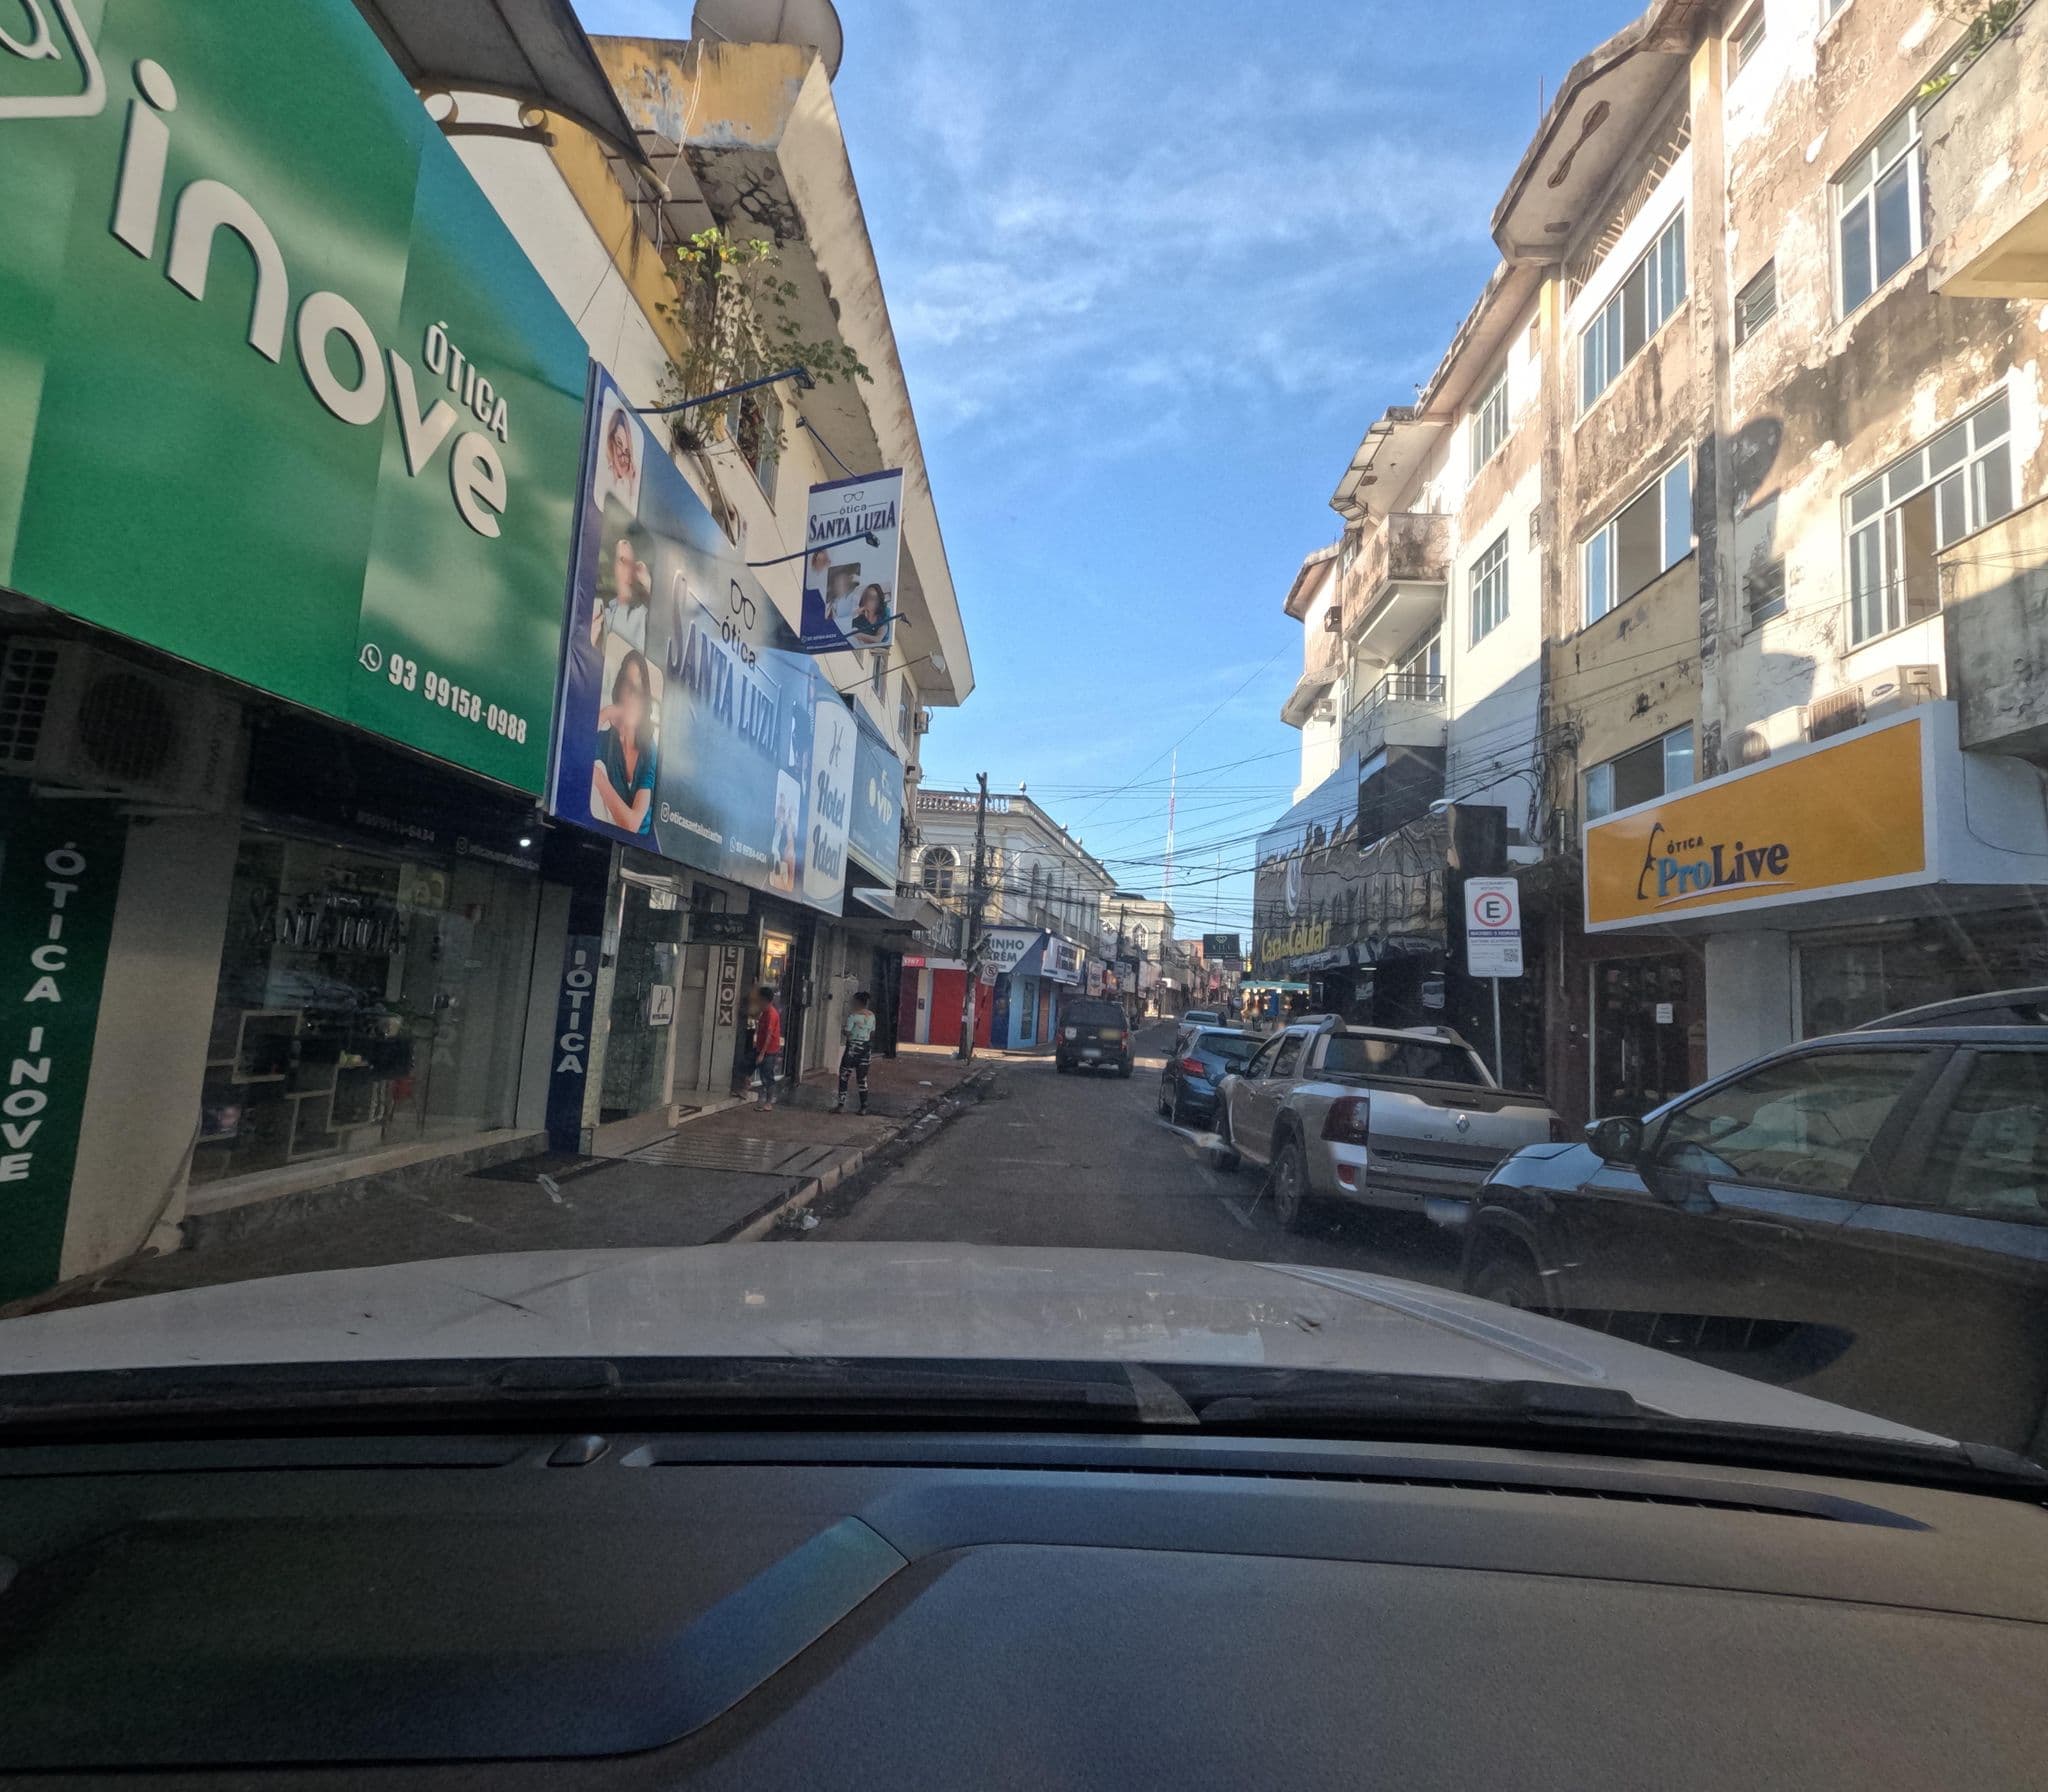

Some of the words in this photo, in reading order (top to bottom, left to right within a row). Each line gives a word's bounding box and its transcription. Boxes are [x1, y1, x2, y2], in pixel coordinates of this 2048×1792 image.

[111, 58, 508, 539] inove
[425, 320, 510, 444] ÓTICA
[809, 514, 852, 543] SANTA
[856, 501, 897, 533] LUZIA
[839, 503, 868, 515] ótica
[666, 569, 734, 730] SANTA
[721, 615, 757, 672] ótica
[388, 653, 418, 692] 93
[424, 671, 528, 745] 99158-0988
[817, 770, 847, 831] Hotel
[876, 790, 893, 825] VIP
[812, 824, 843, 881] Ideal
[1657, 841, 1790, 897] ProLive
[1667, 836, 1705, 854] ÓTICA
[23, 841, 86, 1003] ÓTICA
[1289, 914, 1332, 957] Celular
[1486, 901, 1501, 919] E
[0, 1026, 51, 1183] INOVE
